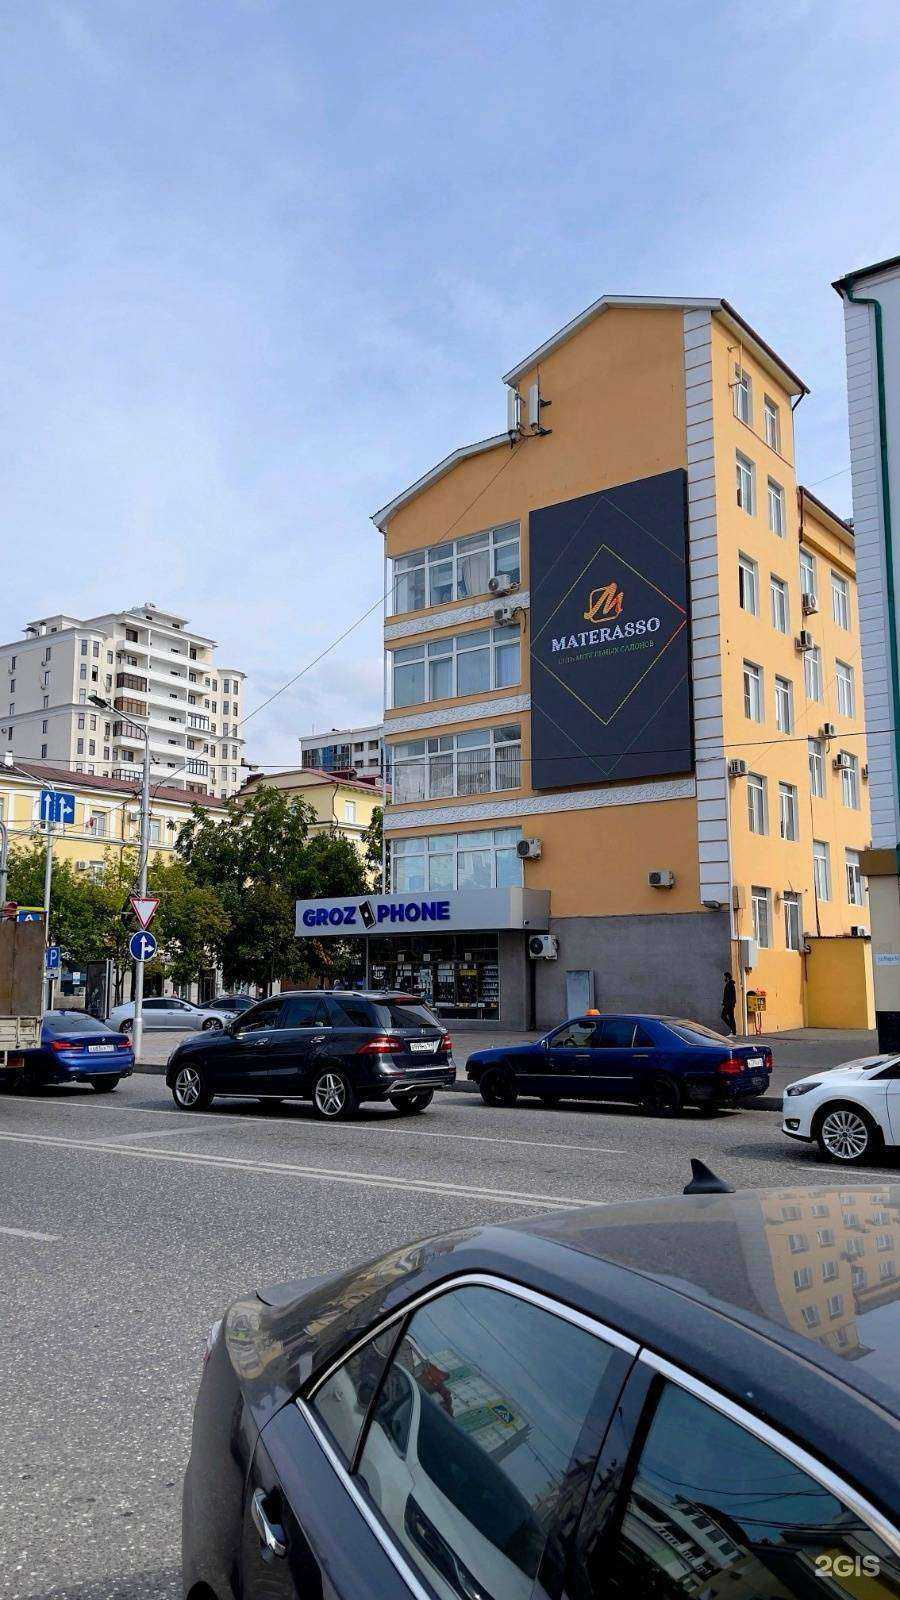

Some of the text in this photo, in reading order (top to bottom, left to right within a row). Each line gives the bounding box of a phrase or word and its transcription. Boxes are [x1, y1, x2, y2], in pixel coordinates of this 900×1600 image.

[551, 617, 661, 652] MATERASSO
[302, 901, 450, 927] GROZ PHONE
